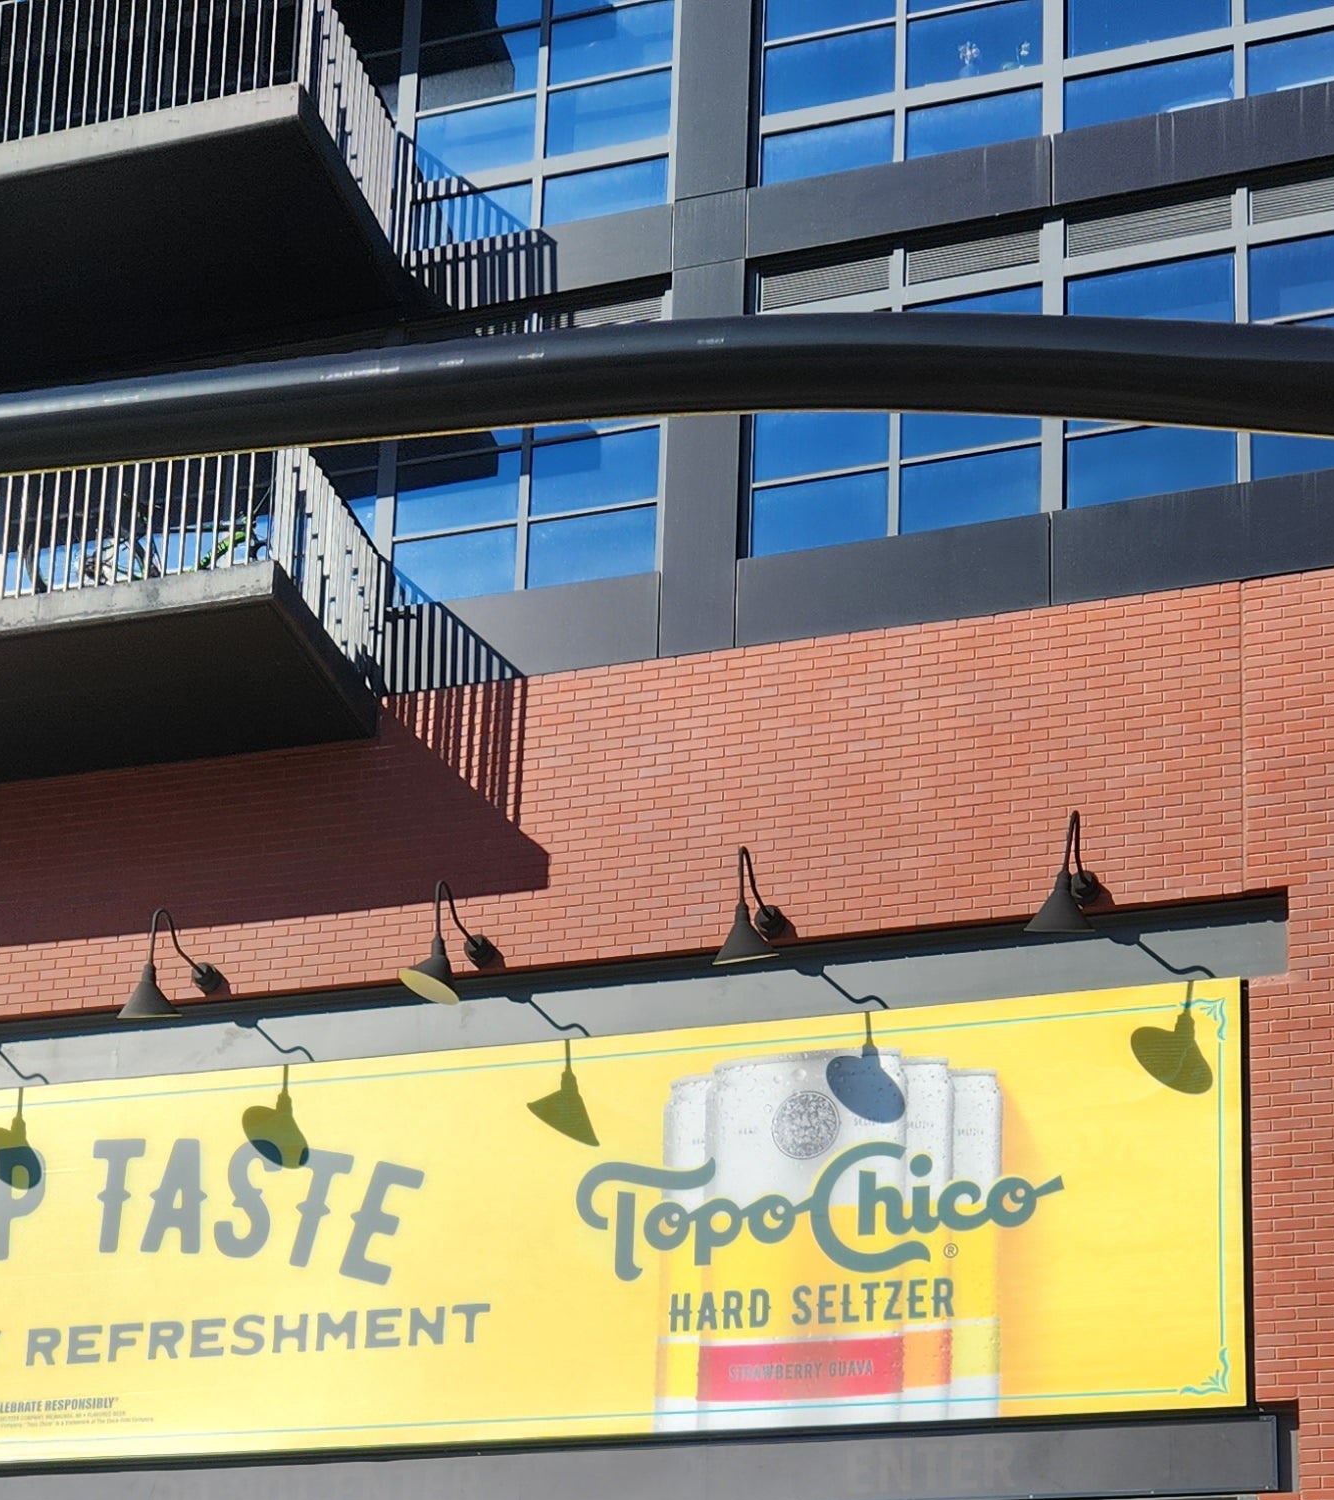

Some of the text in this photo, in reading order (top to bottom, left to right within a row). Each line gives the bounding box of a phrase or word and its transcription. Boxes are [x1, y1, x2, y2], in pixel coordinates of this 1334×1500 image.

[93, 1136, 426, 1287] TASTE
[575, 1140, 1065, 1282] Topo Chico
[25, 1302, 492, 1367] REFRESHMENT
[668, 1276, 956, 1333] HARD SELTZER
[729, 1359, 874, 1382] STRAWBERRY GUAVA
